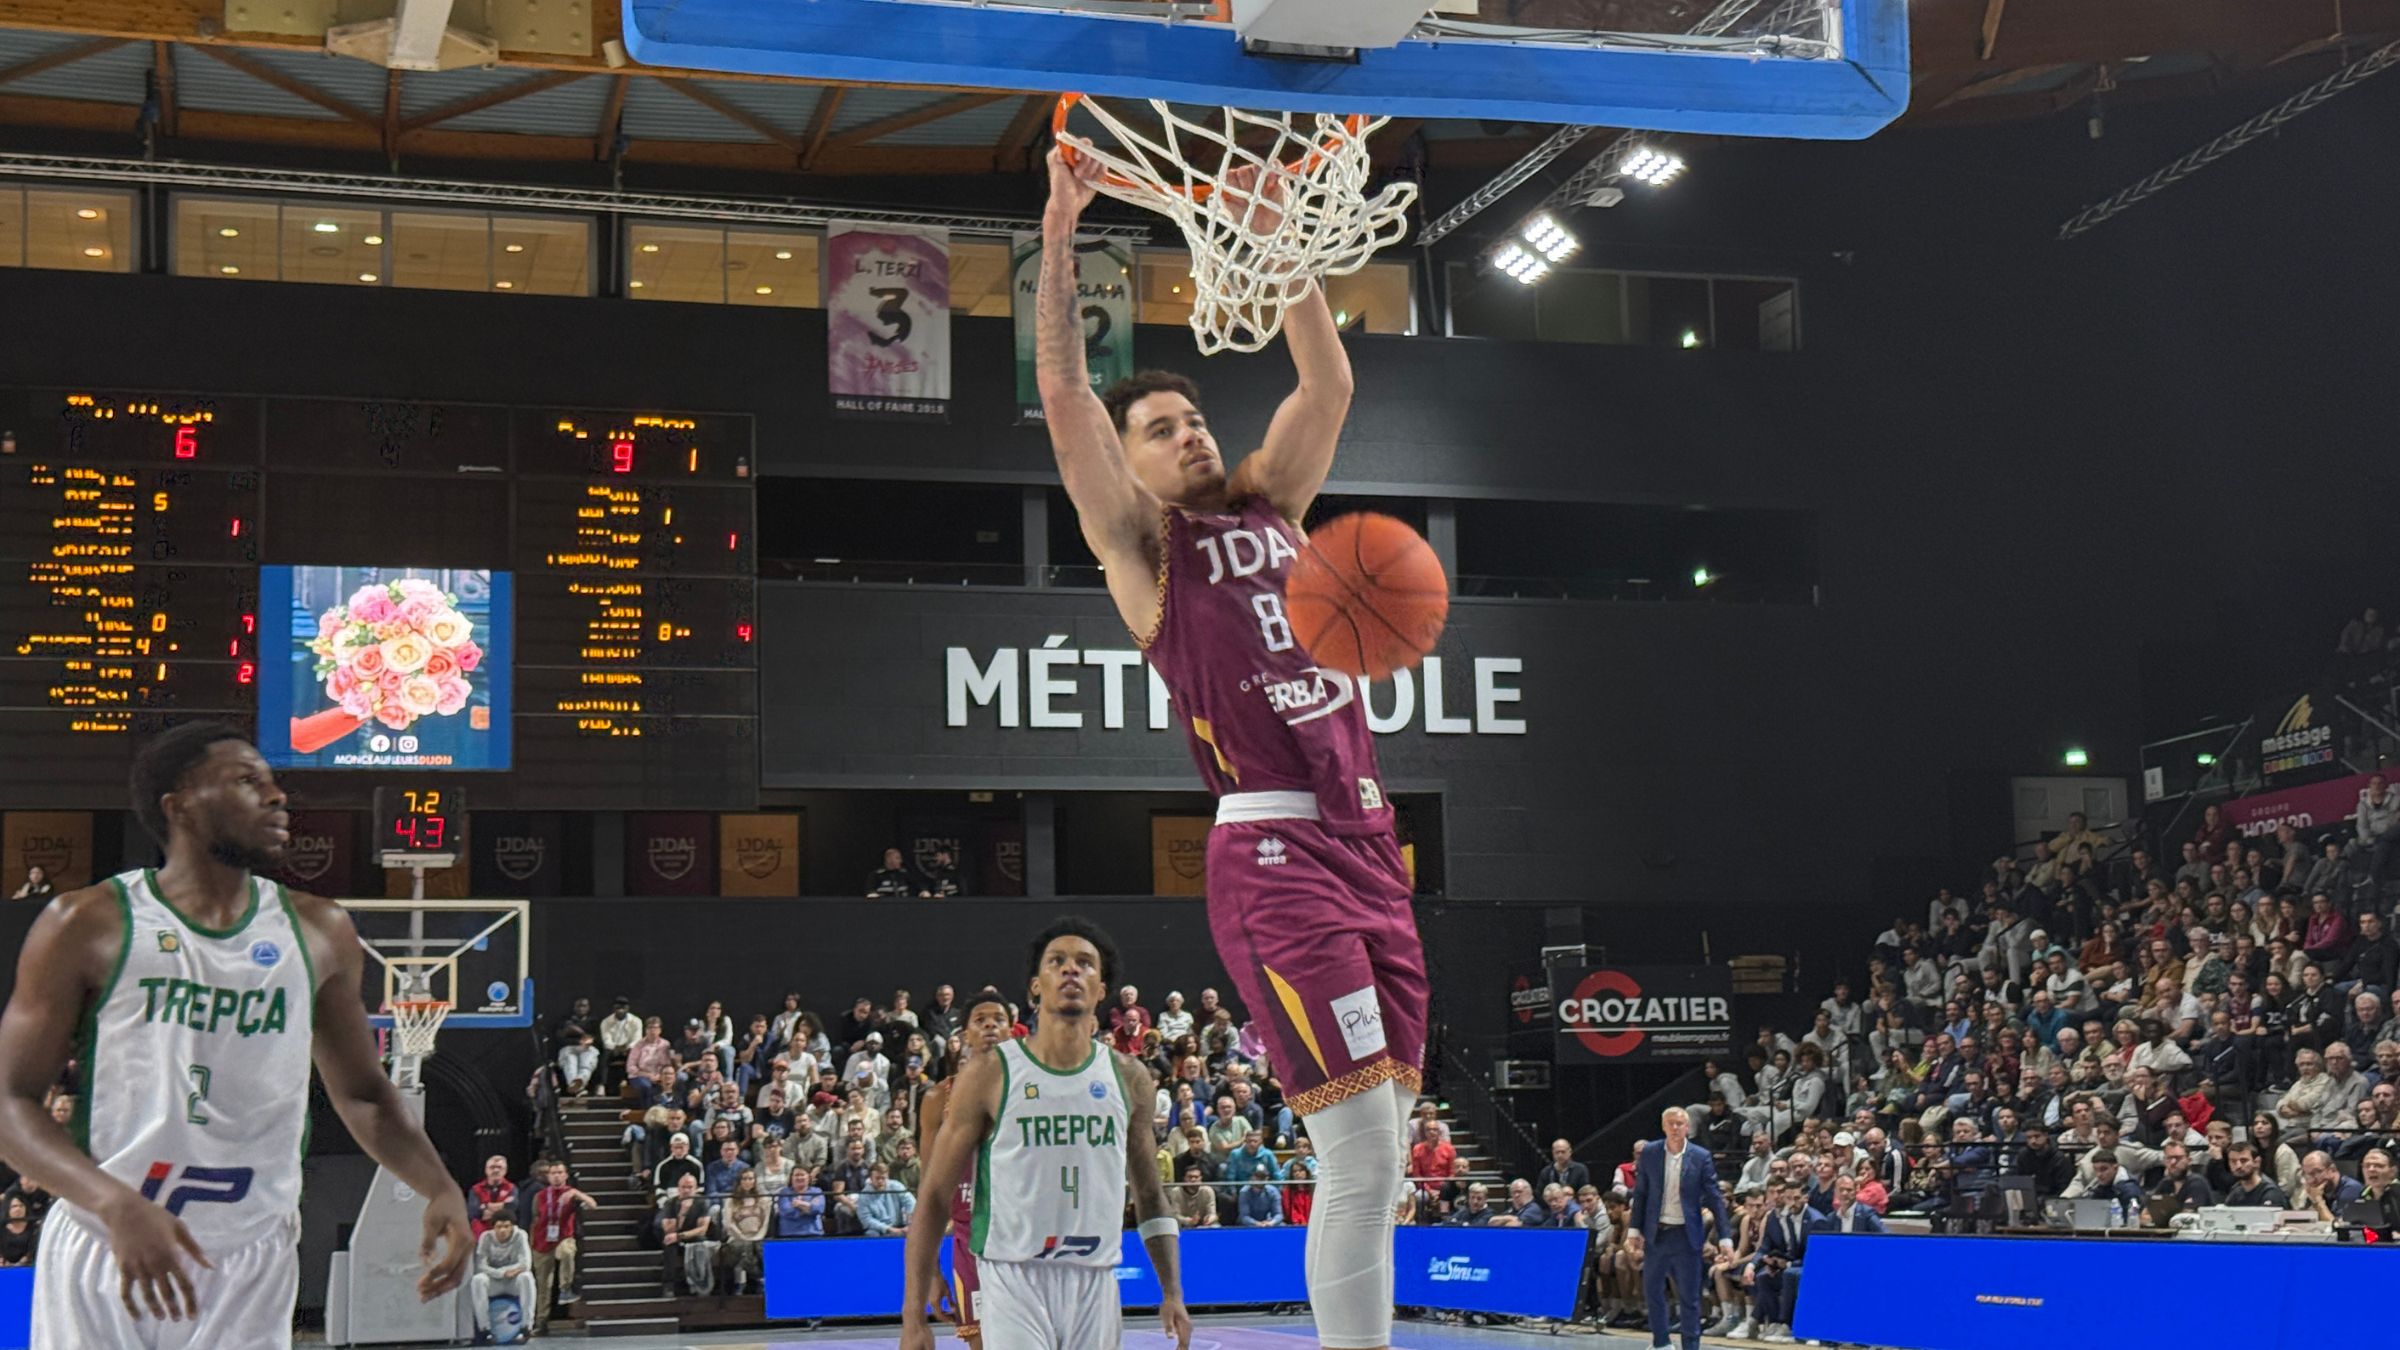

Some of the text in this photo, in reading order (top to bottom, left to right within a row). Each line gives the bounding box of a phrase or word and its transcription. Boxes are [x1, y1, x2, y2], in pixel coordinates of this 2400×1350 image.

[855, 259, 921, 279] L. TERZI
[868, 286, 912, 348] 3
[175, 426, 197, 459] 6
[613, 443, 633, 472] 9
[153, 492, 168, 512] 5
[1196, 527, 1298, 585] JDA
[242, 614, 254, 633] 7
[658, 622, 671, 642] 8
[737, 625, 752, 642] 4
[1252, 592, 1294, 653] 8
[136, 638, 150, 655] 4
[238, 663, 254, 684] 2
[945, 634, 1527, 735] MÉTOLE
[2262, 725, 2331, 754] message
[403, 791, 440, 814] 7.2
[395, 817, 445, 848] 4.3
[139, 976, 287, 1038] TREPÇA
[1558, 996, 1730, 1024] CROZATIER
[187, 1064, 212, 1125] 2
[1016, 1114, 1117, 1149] TREPÇA
[1061, 1165, 1080, 1209] 4
